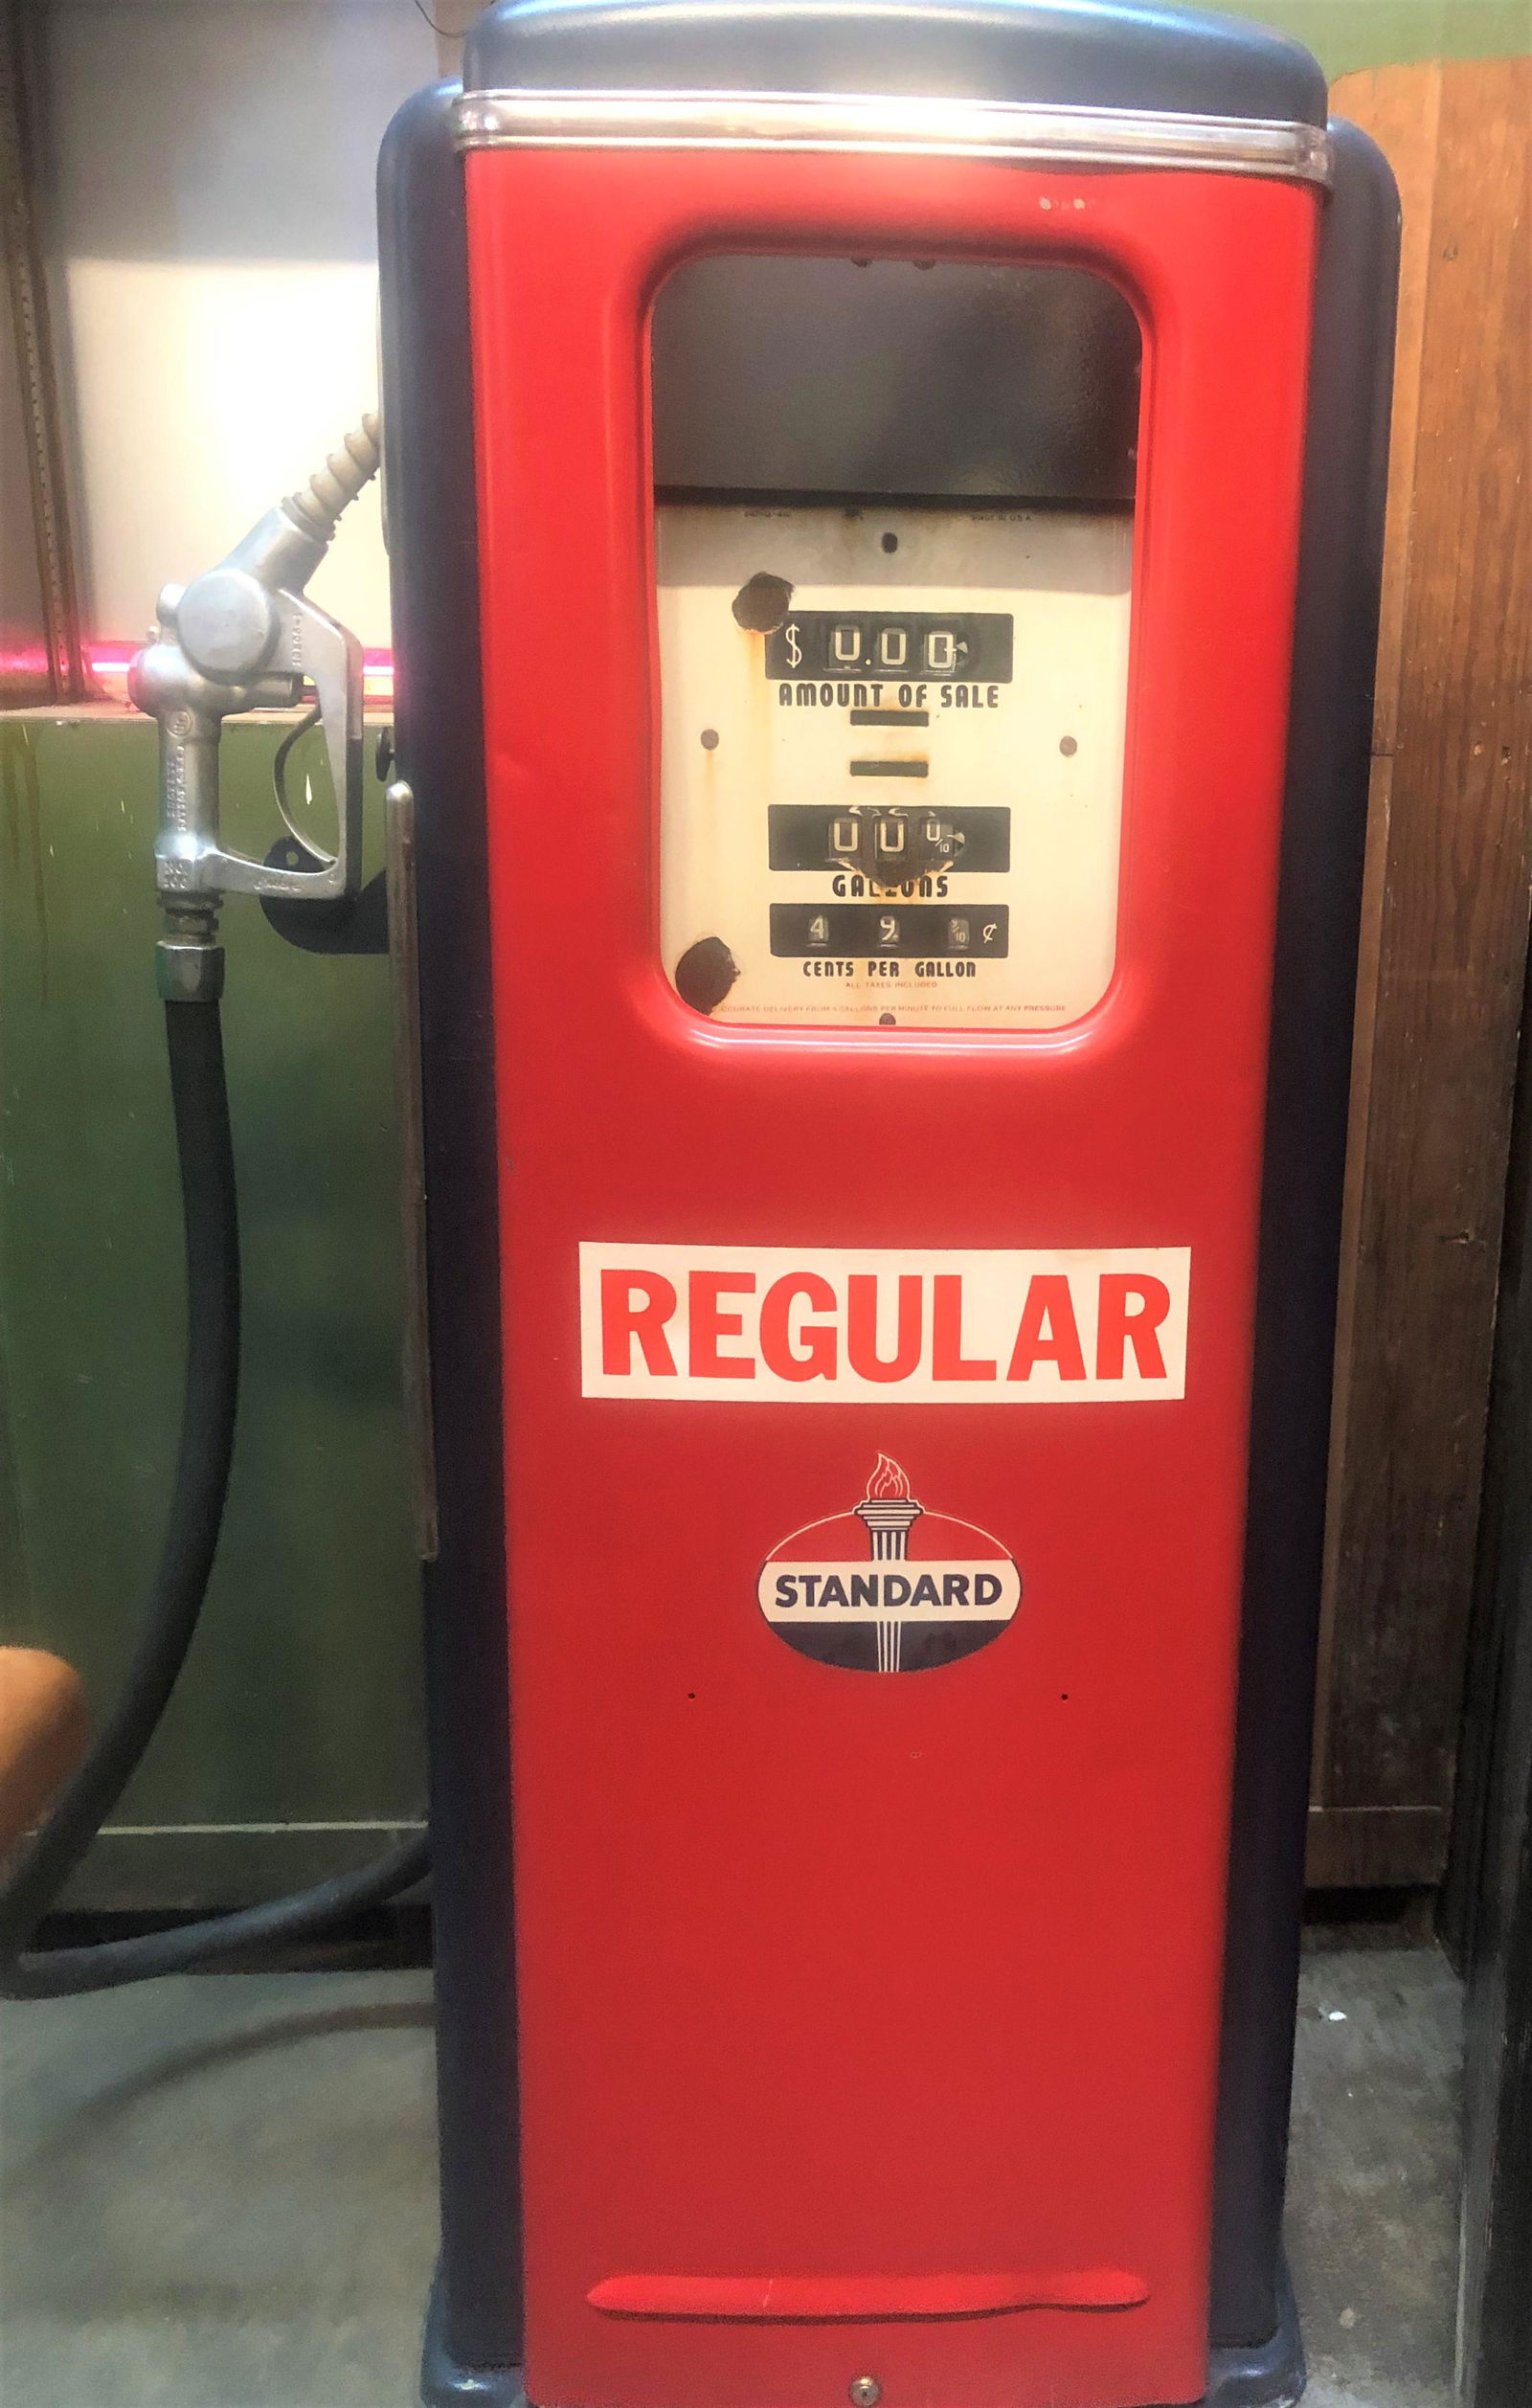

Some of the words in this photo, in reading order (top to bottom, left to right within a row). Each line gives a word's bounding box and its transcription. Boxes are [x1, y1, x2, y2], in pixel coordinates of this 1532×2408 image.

[778, 683, 884, 707] AMOUNT
[898, 684, 928, 708] OF
[940, 685, 1000, 709] SALE
[802, 960, 855, 978] CENTS
[867, 960, 900, 978] PER
[914, 960, 977, 978] GALLON
[845, 980, 862, 990] ALL
[866, 980, 891, 990] TAXES
[894, 980, 938, 989] INCLUDED
[600, 1269, 1171, 1383] REGULAR
[775, 1574, 1003, 1608] STANDARD
